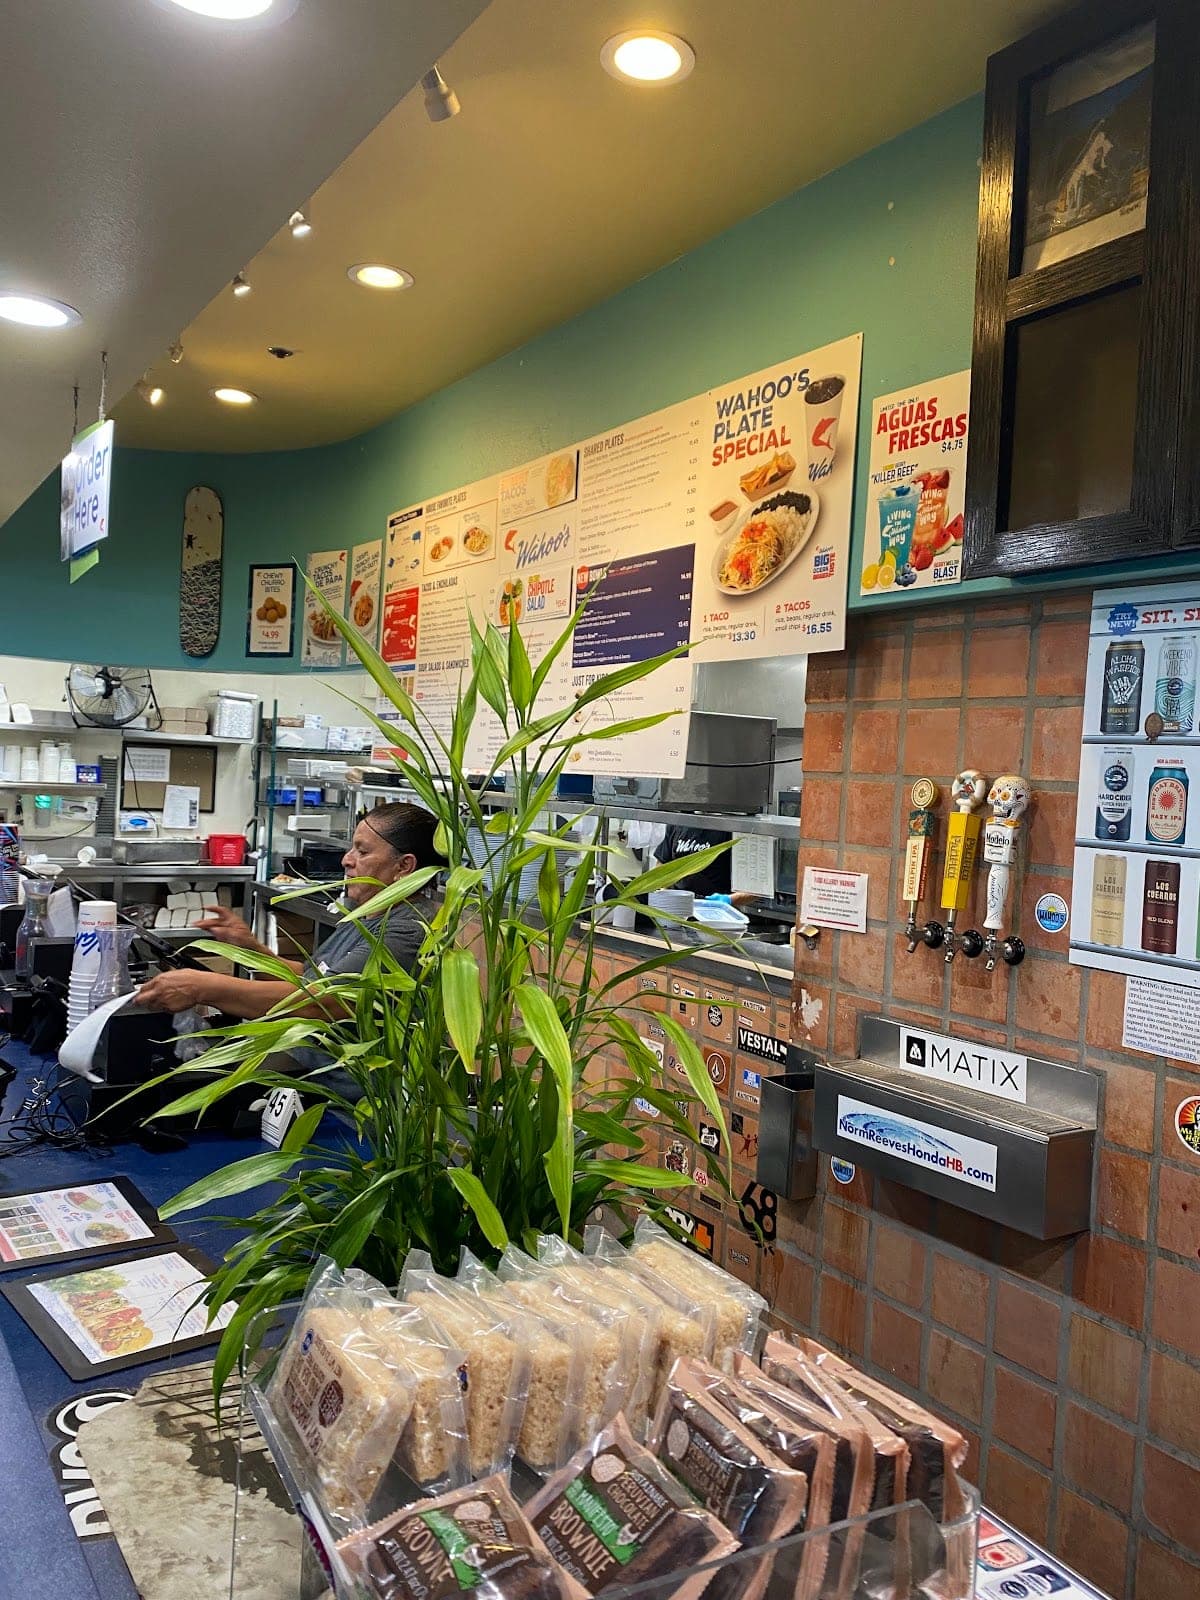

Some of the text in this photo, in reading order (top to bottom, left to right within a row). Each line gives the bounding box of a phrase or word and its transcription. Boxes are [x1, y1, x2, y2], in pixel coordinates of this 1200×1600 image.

[716, 368, 810, 419] WAHOO'S
[876, 397, 938, 435] AGUAS
[713, 405, 773, 443] PLATE
[888, 412, 967, 454] FRESCAS
[711, 425, 791, 467] SPECIAL
[941, 438, 963, 453] $4.75
[74, 494, 99, 534] Here
[886, 509, 912, 524] LIVING
[516, 523, 571, 570] Wahoo's
[814, 553, 830, 567] BIG
[313, 570, 333, 580] TACOS
[933, 565, 958, 579] BLAST
[315, 574, 343, 588] DE PAPA
[528, 578, 555, 597] CHIPOTLE
[527, 595, 546, 612] SALAD
[775, 600, 810, 613] 2 TACOS
[709, 612, 729, 621] TACO
[803, 612, 821, 621] regular
[1114, 611, 1132, 620] TRY
[1141, 607, 1200, 624] SIT, SI
[801, 622, 832, 635] $16.55
[1109, 620, 1136, 629] NEW!
[262, 630, 280, 639] $4.99
[1110, 655, 1137, 666] ALOHA
[1163, 648, 1193, 660] WEEKEND
[1106, 664, 1141, 676] WARRIOR
[1165, 659, 1189, 677] VIBES
[572, 674, 584, 687] JUST
[585, 674, 595, 686] FOR
[1098, 793, 1114, 801] HARD
[986, 832, 1010, 847] Modelo
[908, 861, 917, 896] SCULPIN
[1155, 881, 1169, 891] LOS
[1147, 889, 1176, 901] CUERNOS
[1157, 917, 1174, 925] BLEND
[739, 1028, 781, 1057] VESTAL
[931, 1044, 1019, 1092] MATIX
[267, 1090, 287, 1119] 45
[839, 1118, 994, 1184] NormReevesHondaHB.com
[616, 1473, 660, 1519] PERUVIAN
[607, 1483, 650, 1531] CHOCOLATE
[549, 1499, 616, 1579] BROWNIE
